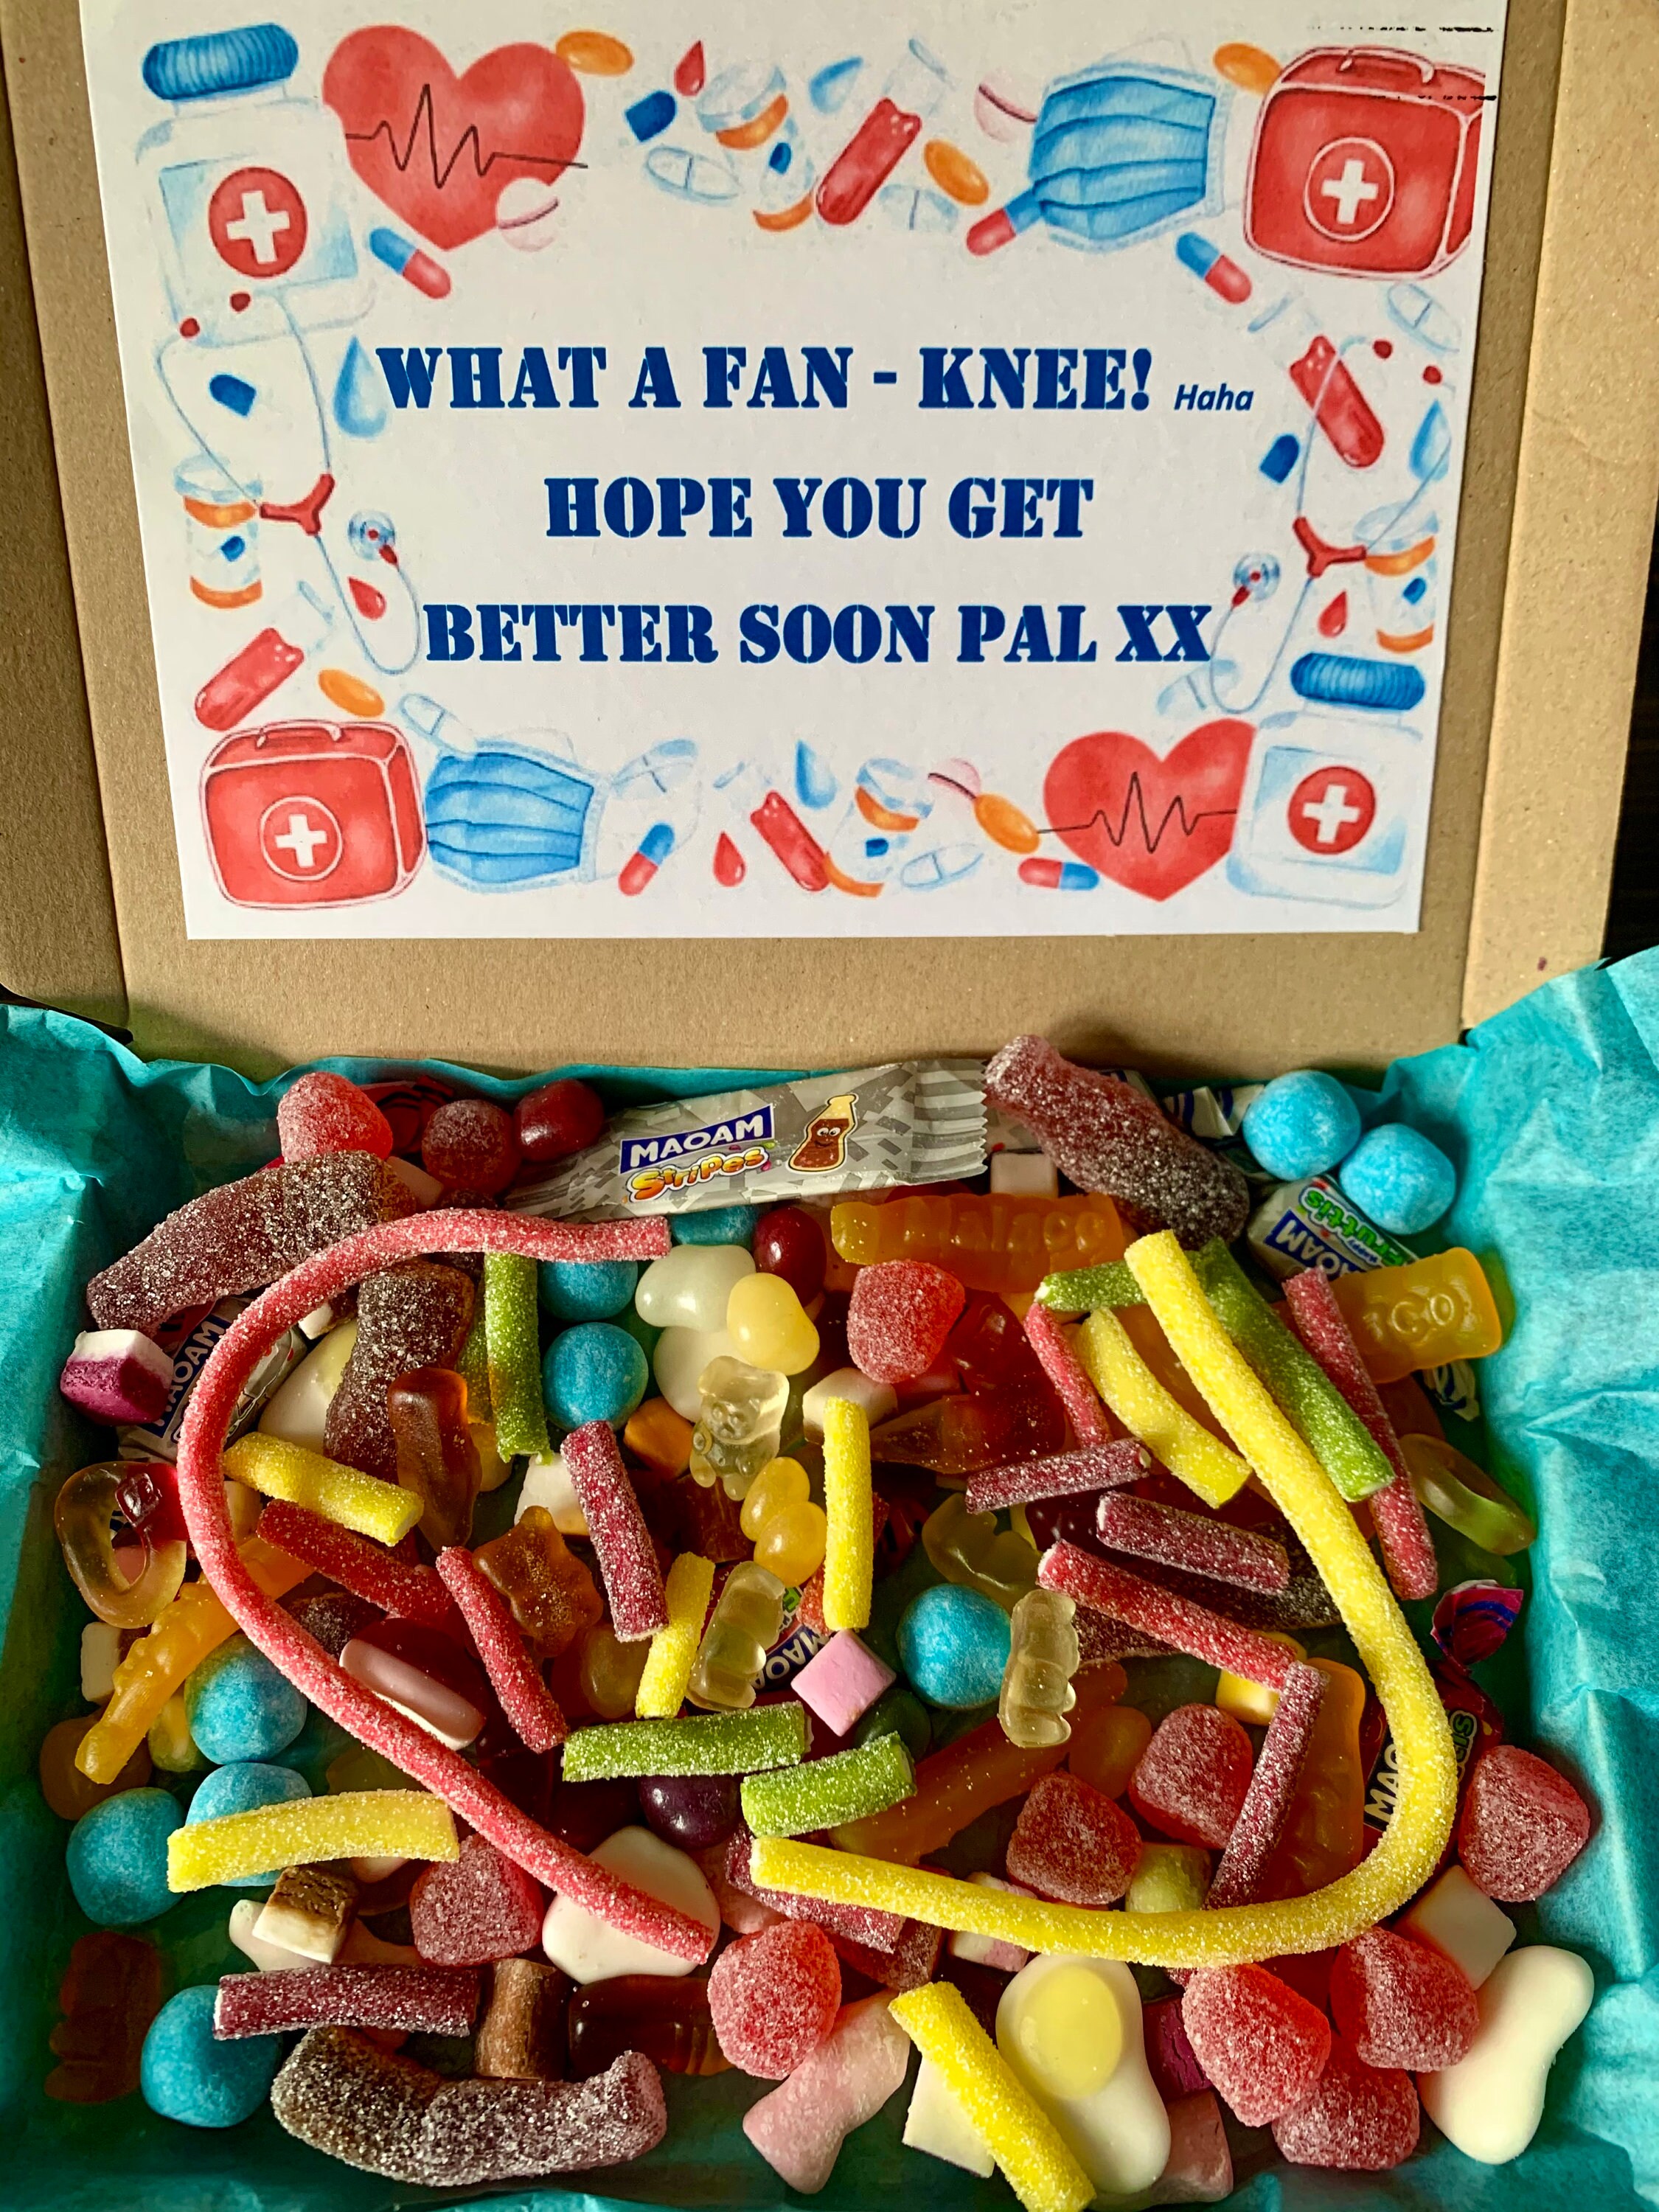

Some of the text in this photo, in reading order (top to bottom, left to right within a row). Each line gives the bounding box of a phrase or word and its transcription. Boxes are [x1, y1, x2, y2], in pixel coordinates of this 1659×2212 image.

[375, 347, 607, 409] WHAT
[628, 347, 681, 409] A
[703, 347, 853, 409] FAN
[919, 347, 1152, 411] KNEE!
[1174, 383, 1254, 411] Haha
[544, 477, 1093, 539] HOPE YOU GET
[422, 603, 1213, 664] BETTER SOON PAL XX
[629, 1114, 765, 1168] MAOAM
